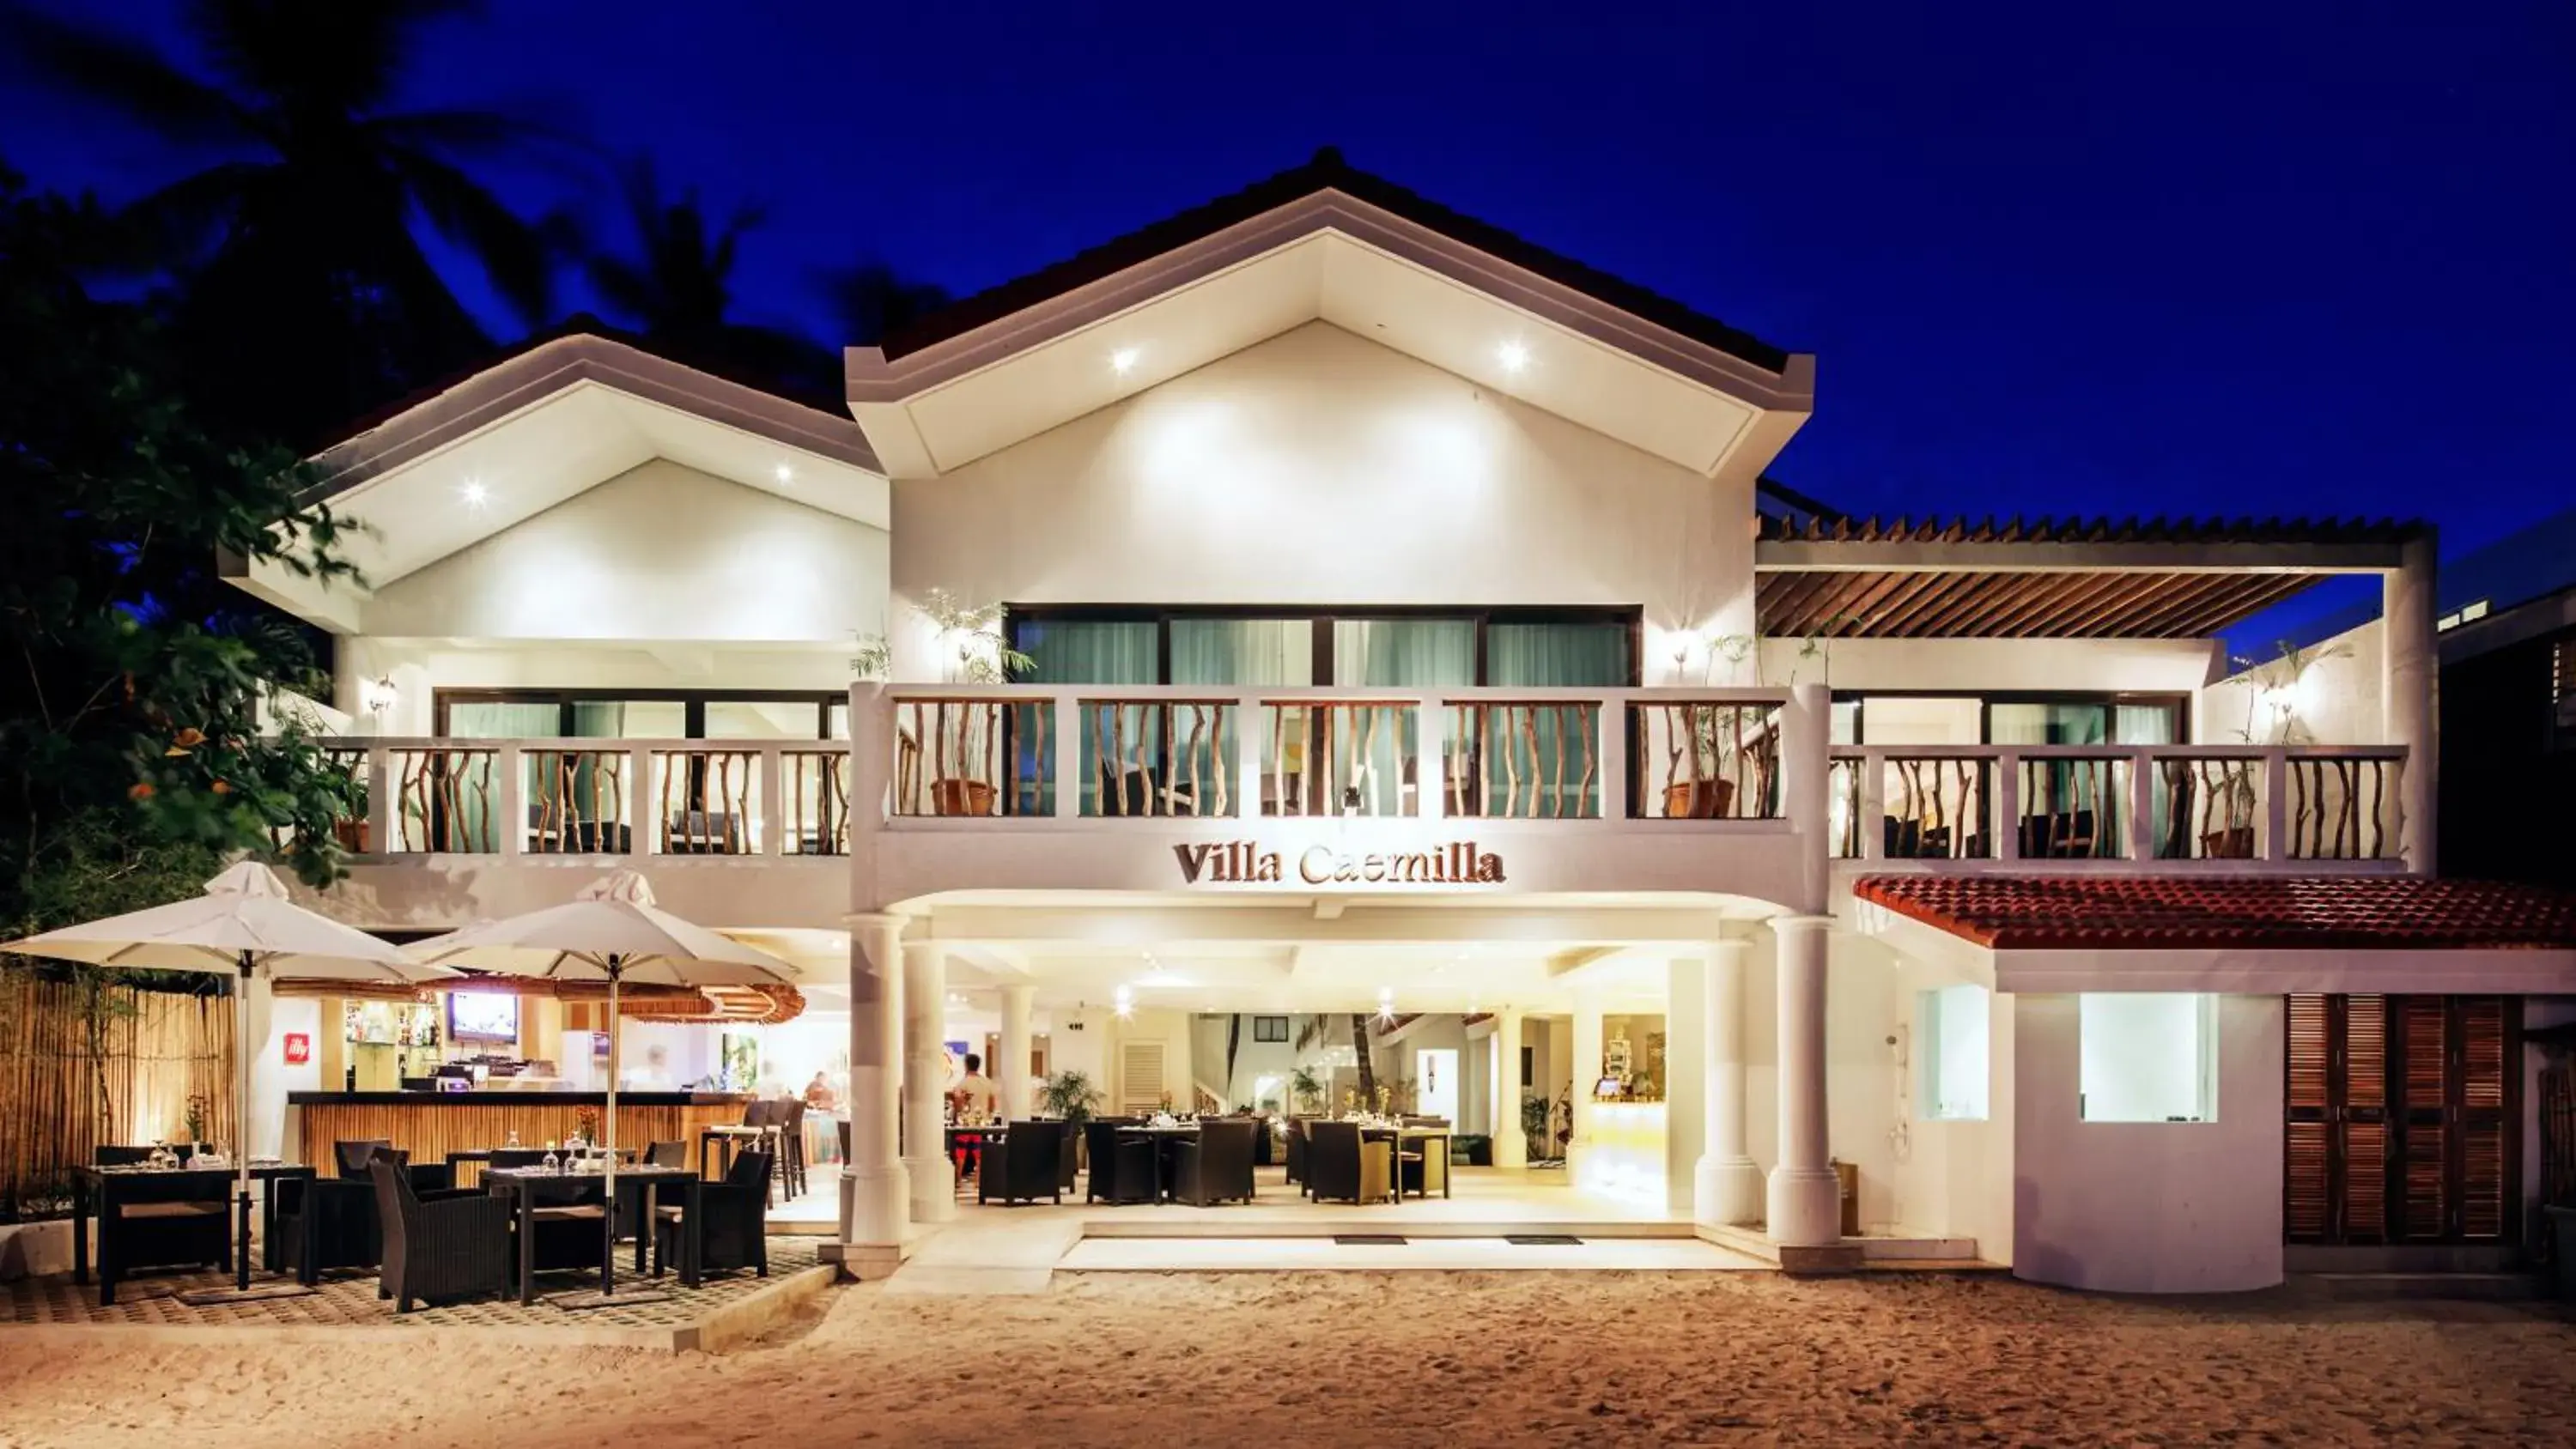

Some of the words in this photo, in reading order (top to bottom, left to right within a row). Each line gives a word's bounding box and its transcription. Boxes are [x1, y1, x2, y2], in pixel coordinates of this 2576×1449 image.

[1174, 840, 1282, 884] Villa
[1300, 841, 1507, 884] Caemilla
[288, 1036, 309, 1058] illy
